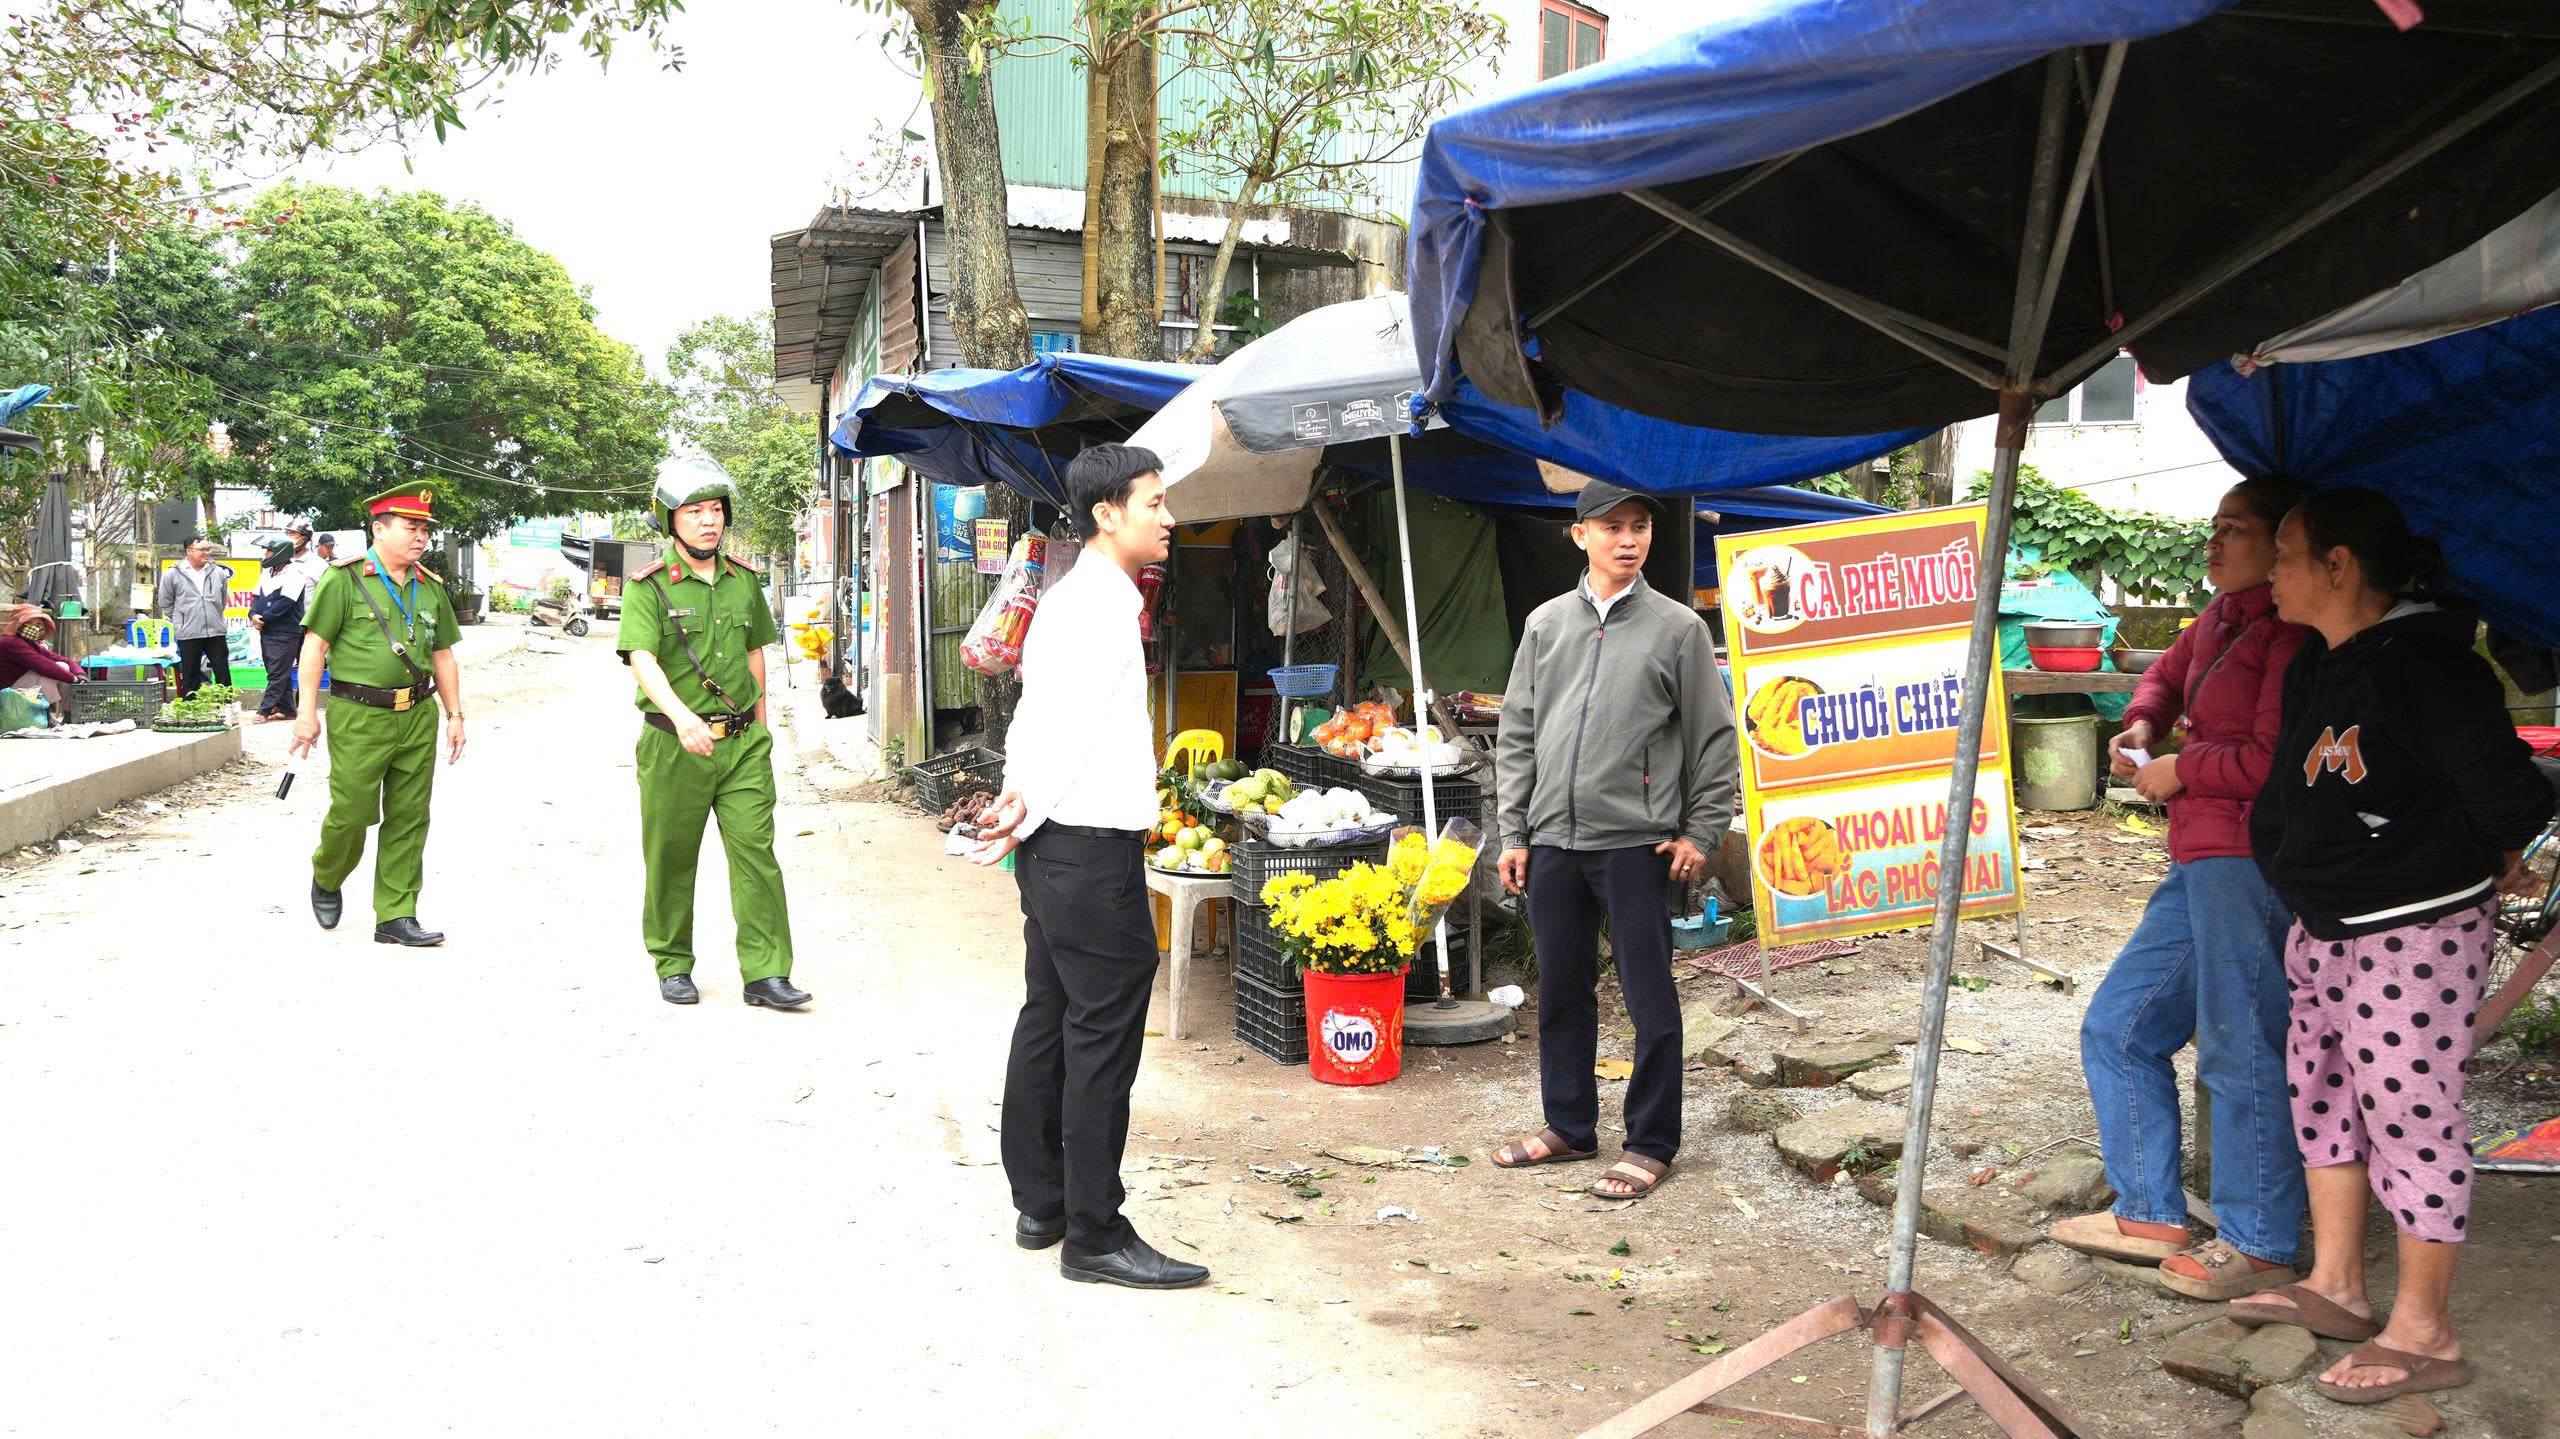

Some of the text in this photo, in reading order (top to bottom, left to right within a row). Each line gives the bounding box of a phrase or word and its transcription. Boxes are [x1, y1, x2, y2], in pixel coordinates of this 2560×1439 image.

[1800, 563, 1839, 620] CÀ
[1844, 555, 1900, 616] PHÊ
[1835, 798, 1988, 853] KHOAI LAG
[1824, 854, 1880, 913] LẮC
[1885, 850, 1941, 905] PHÔ
[1333, 1030, 1373, 1052] OMO
